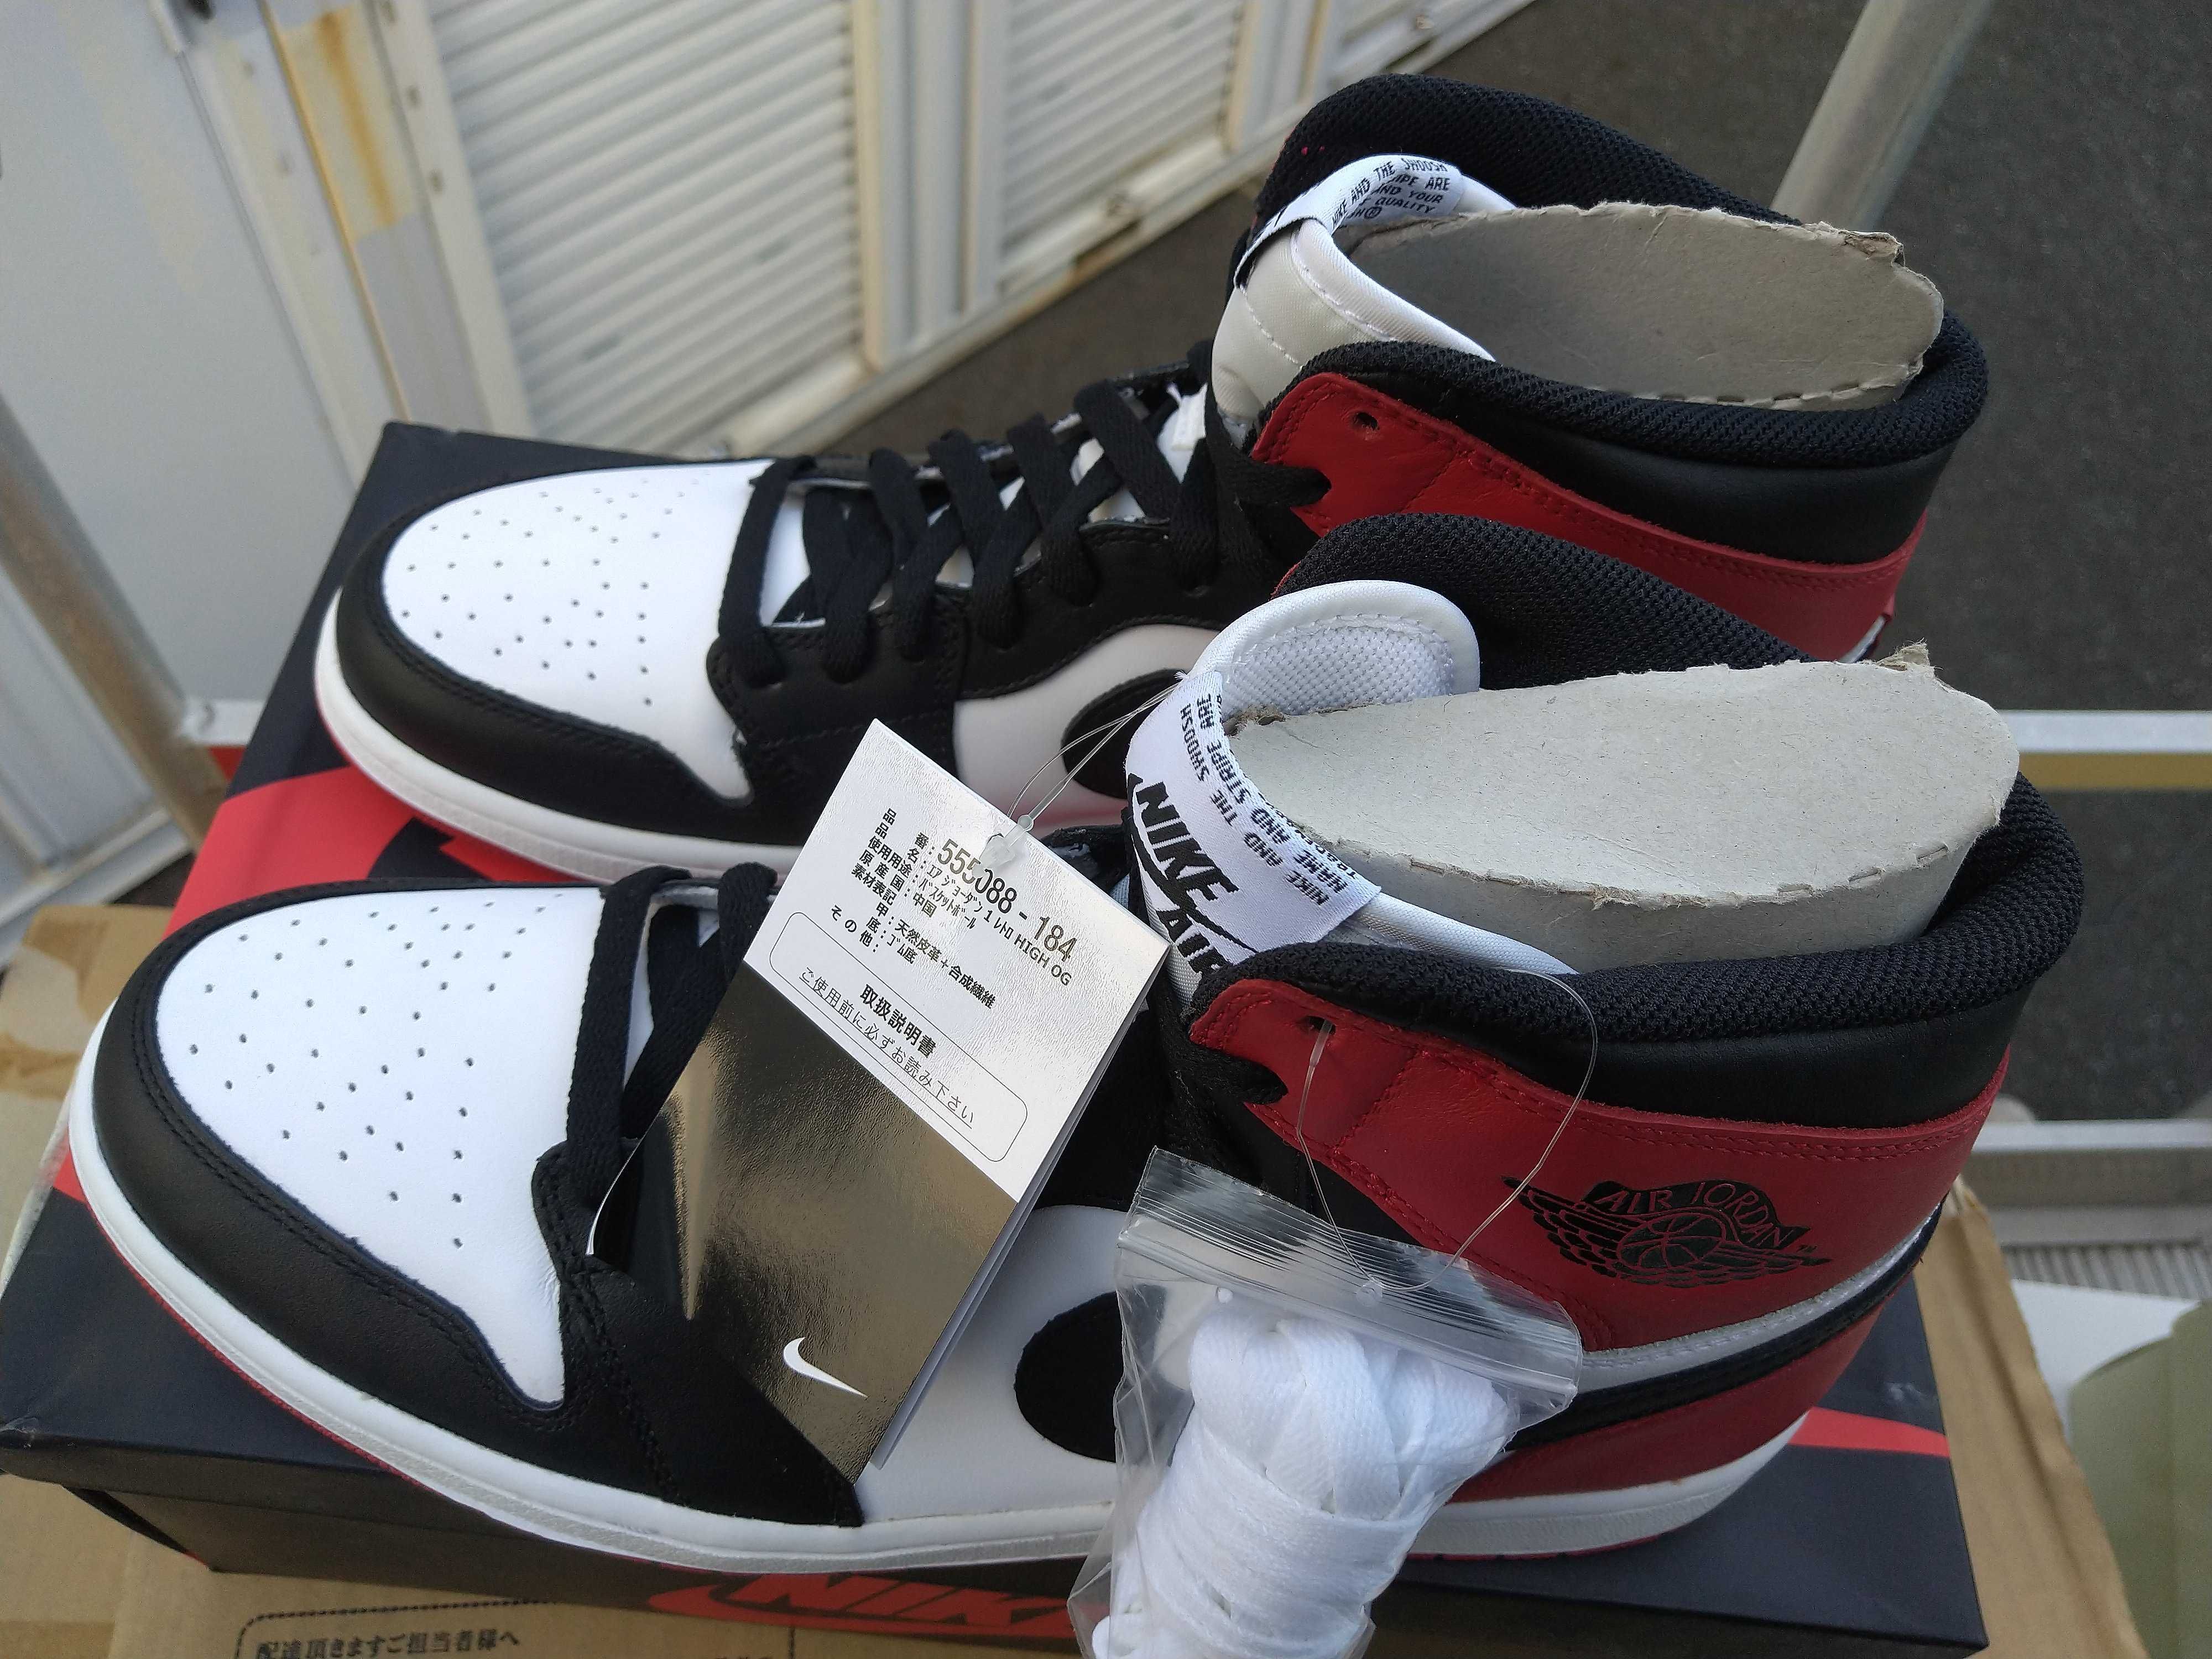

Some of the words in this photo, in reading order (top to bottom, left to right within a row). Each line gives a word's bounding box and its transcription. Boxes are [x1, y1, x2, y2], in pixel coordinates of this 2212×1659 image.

[1351, 178, 1371, 205] AND
[1373, 161, 1396, 181] THE
[1375, 197, 1437, 213] QUALITY
[1409, 190, 1443, 204] YOUR
[1425, 178, 1451, 190] ARE
[1197, 693, 1214, 729] ARE
[1181, 703, 1210, 781] SWOOSH
[1207, 739, 1251, 804] STRIPE
[1210, 790, 1238, 827] THE
[1251, 808, 1291, 844] AND
[1135, 781, 1239, 901] NIKE
[1244, 832, 1284, 867] AND
[851, 863, 897, 906] 素材表記
[1285, 870, 1329, 905] NIKE
[1293, 849, 1348, 893] NAME
[1014, 933, 1050, 968] HIGH
[1051, 964, 1072, 986] OG
[1034, 916, 1078, 962] 184
[860, 984, 937, 1058] 取扱説明書
[800, 967, 974, 1123] ご使用前に必ずお読み下さい
[1594, 1190, 1673, 1214] AIR
[1691, 1182, 1794, 1248] JORDAN
